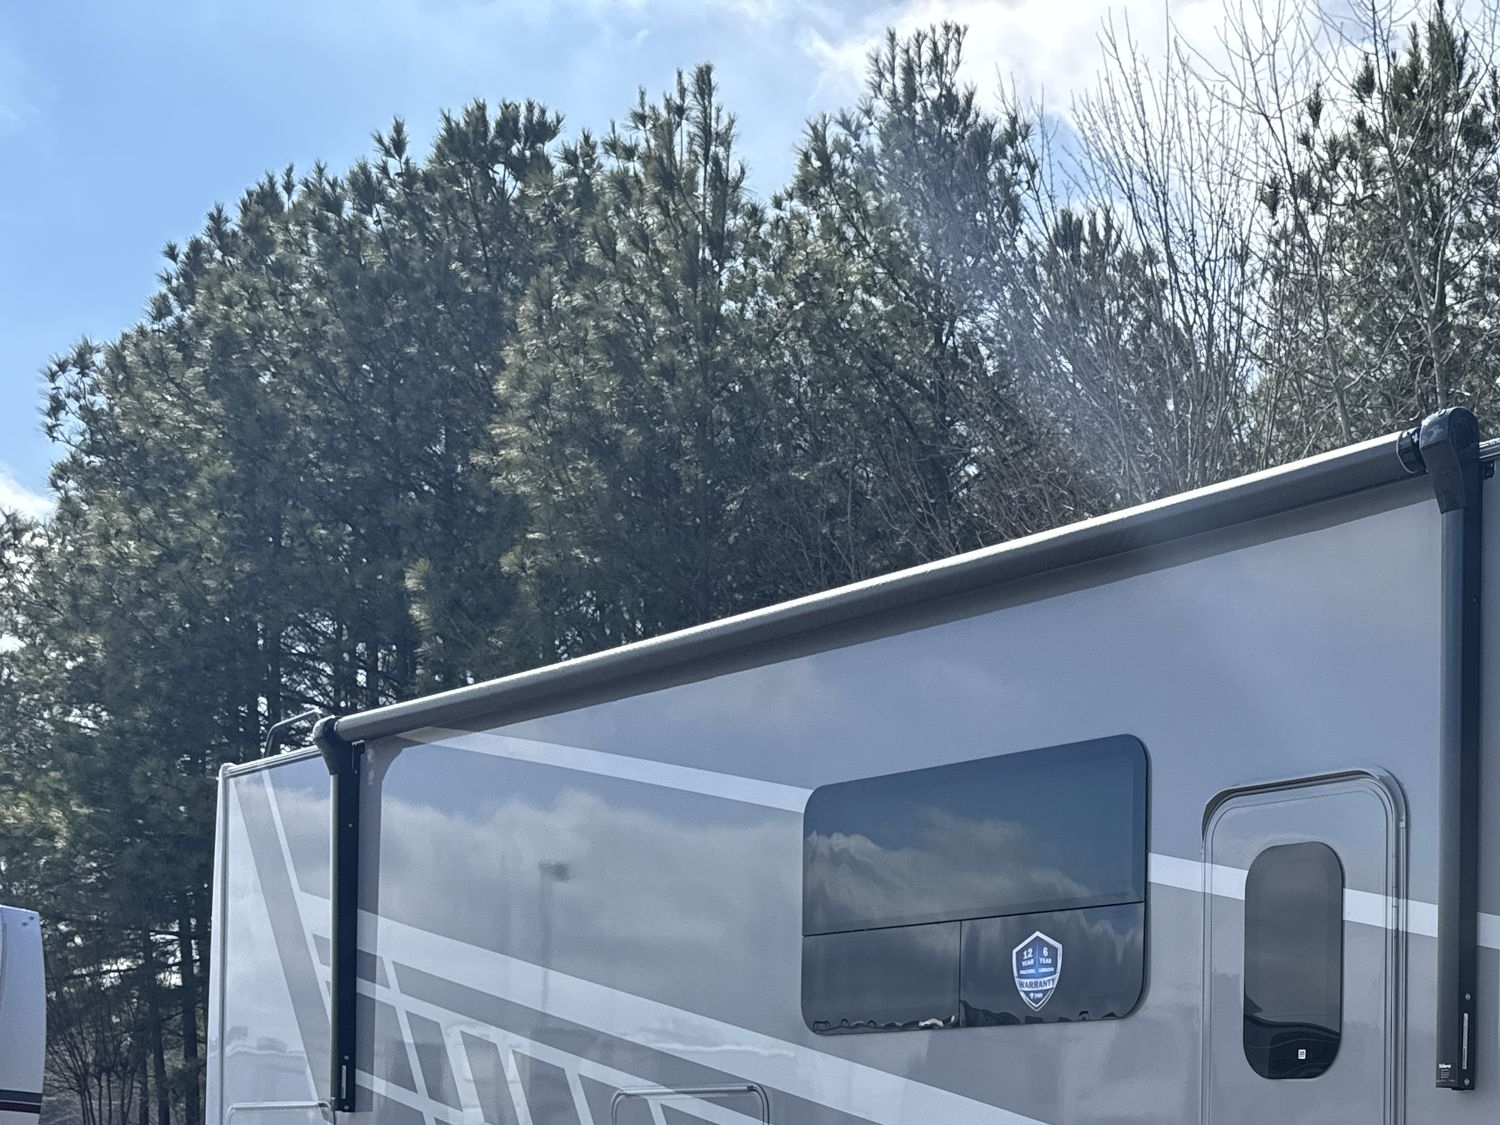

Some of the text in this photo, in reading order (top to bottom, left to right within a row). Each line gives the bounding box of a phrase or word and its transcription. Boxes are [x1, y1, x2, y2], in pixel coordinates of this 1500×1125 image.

[1023, 948, 1033, 960] 12
[1042, 946, 1048, 957] 6
[1020, 979, 1056, 989] WARRANTY
